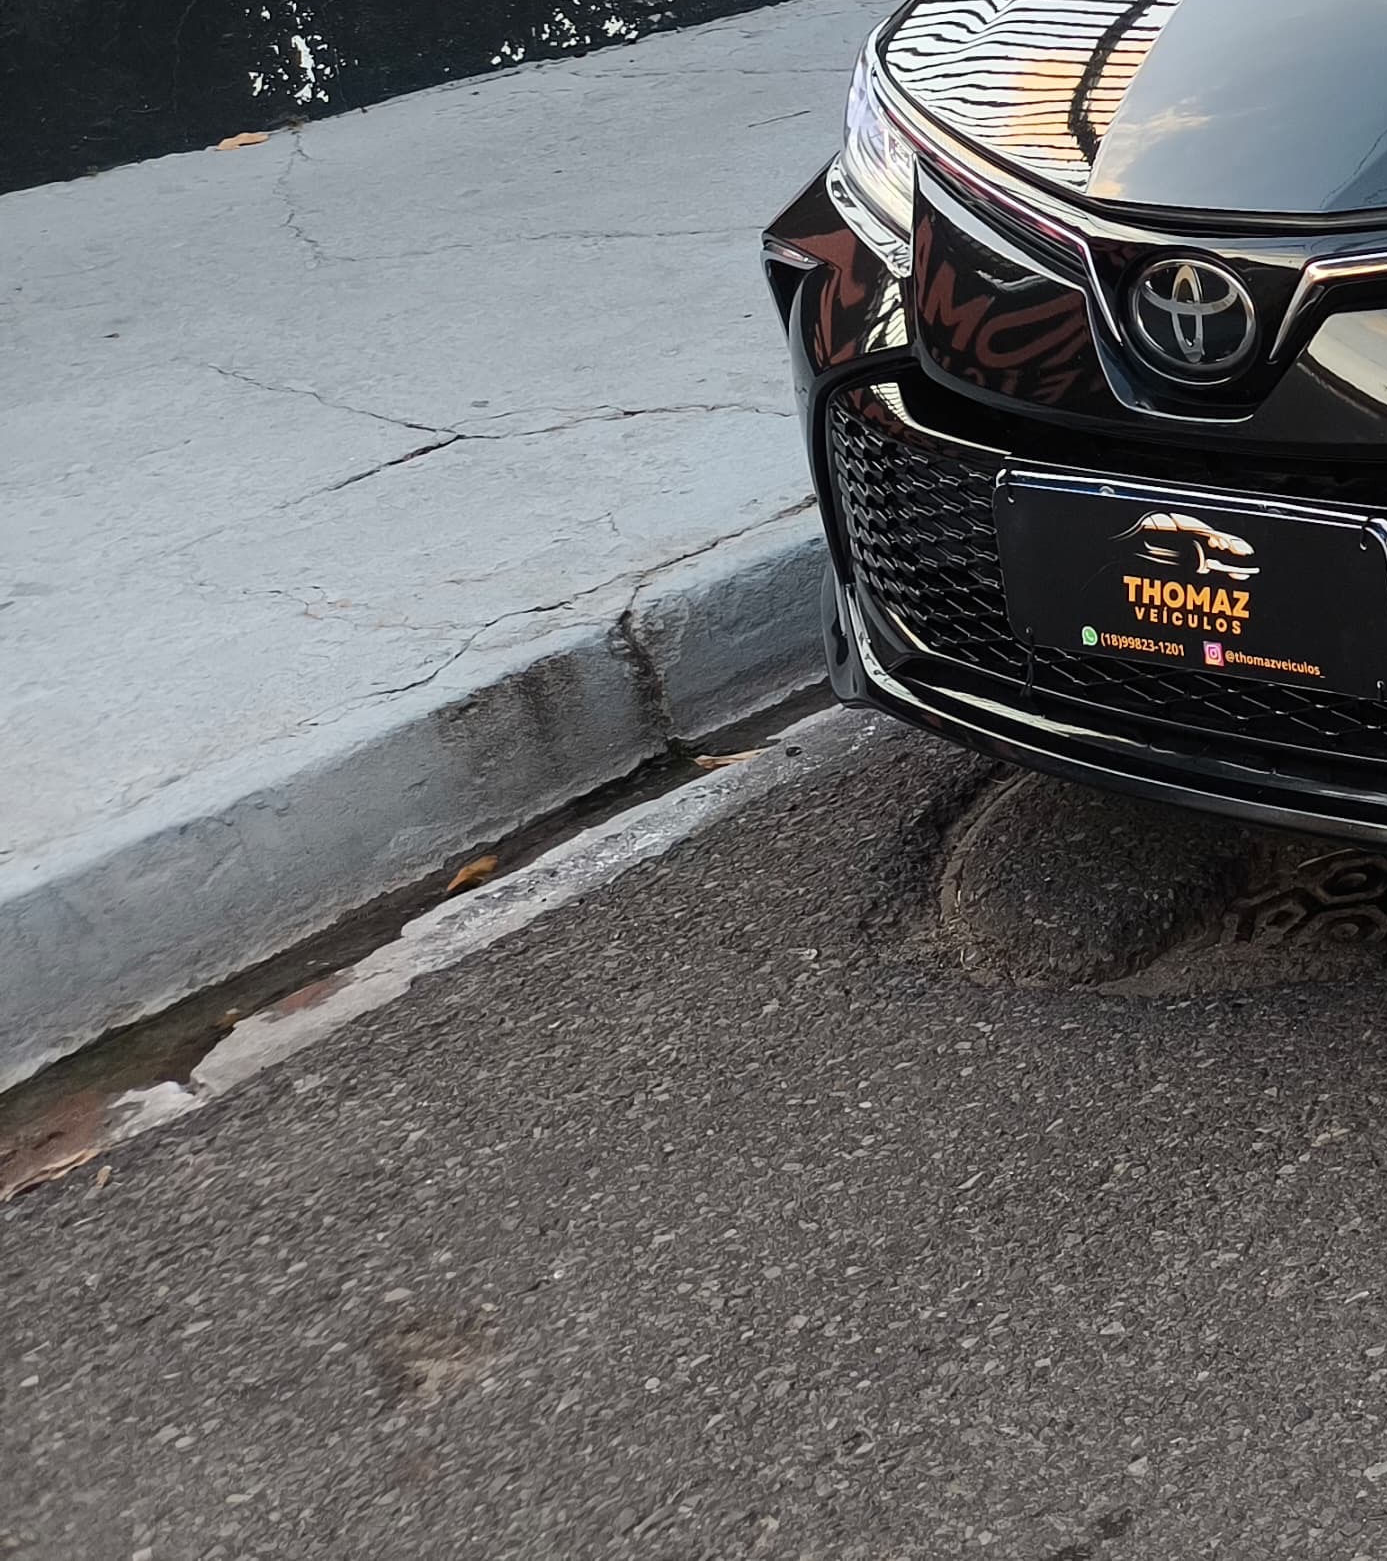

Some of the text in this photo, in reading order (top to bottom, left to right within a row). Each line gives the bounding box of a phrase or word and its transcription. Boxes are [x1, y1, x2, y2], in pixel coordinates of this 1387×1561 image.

[1123, 575, 1251, 619] THOMAZ
[1134, 605, 1242, 635] VEÍCULOS
[1100, 631, 1186, 657] (18)99823-1201
